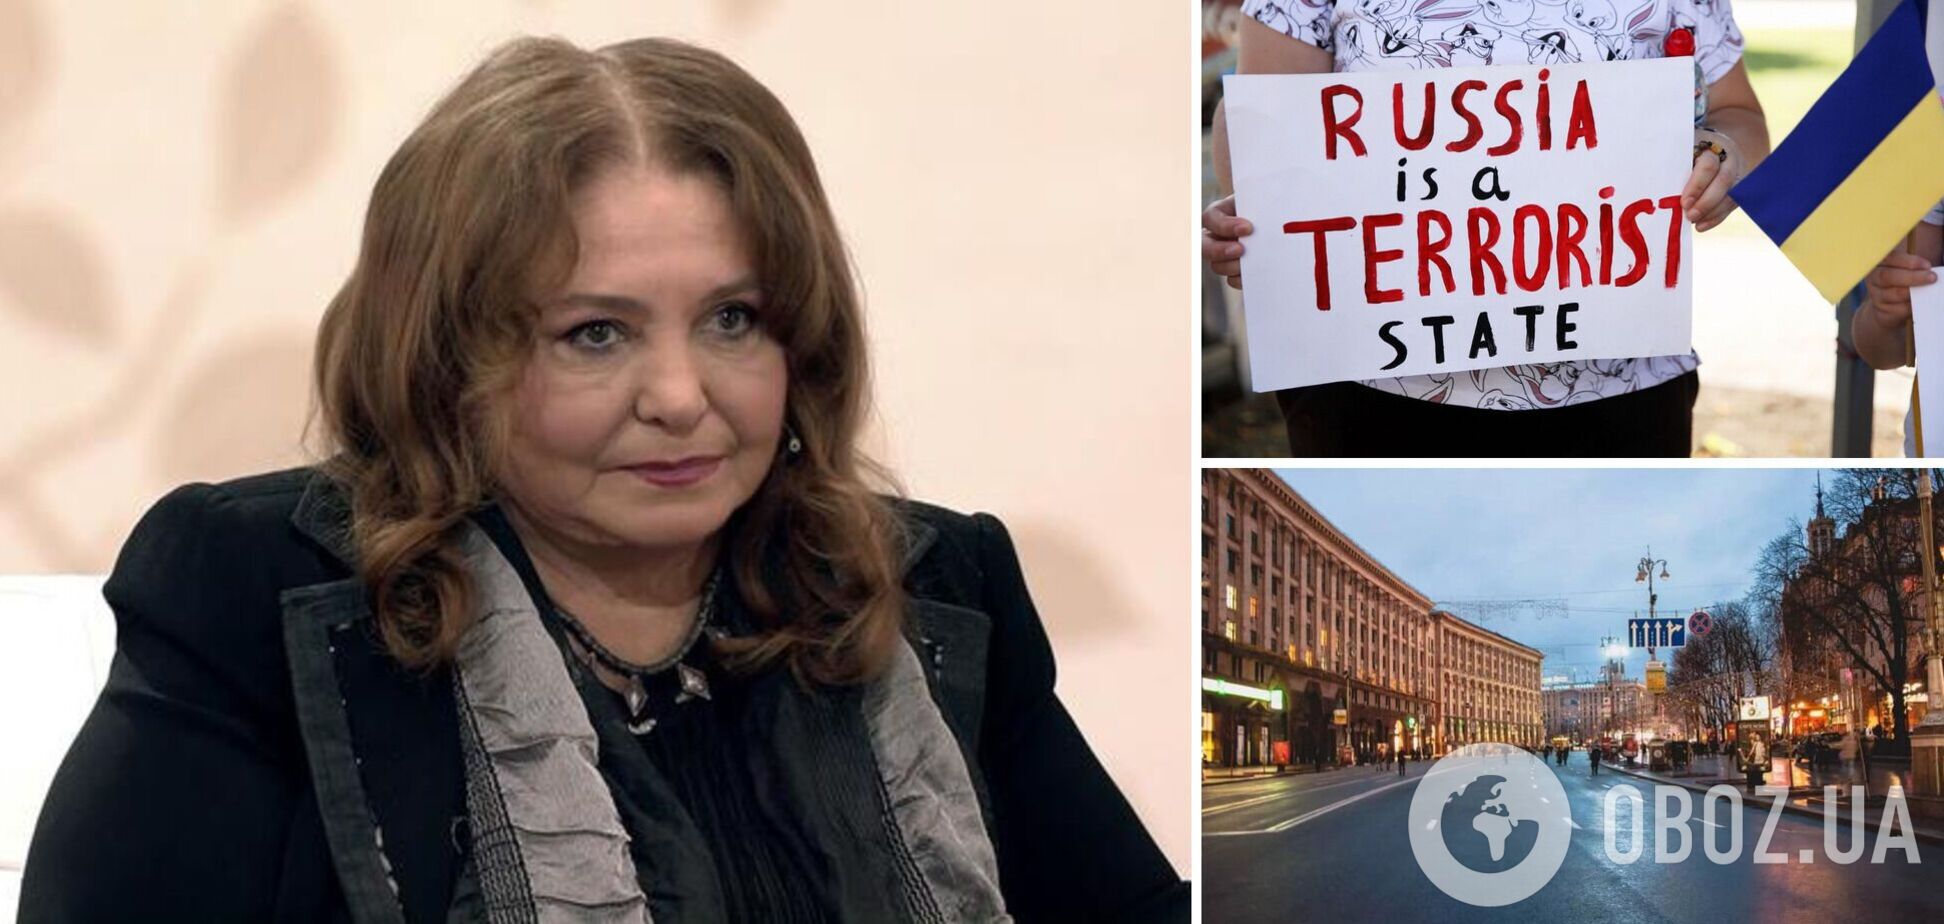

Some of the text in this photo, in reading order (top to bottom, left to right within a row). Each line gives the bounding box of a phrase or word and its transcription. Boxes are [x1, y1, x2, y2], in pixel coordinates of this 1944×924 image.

[1397, 157, 1511, 202] is a
[1378, 303, 1580, 371] STATE
